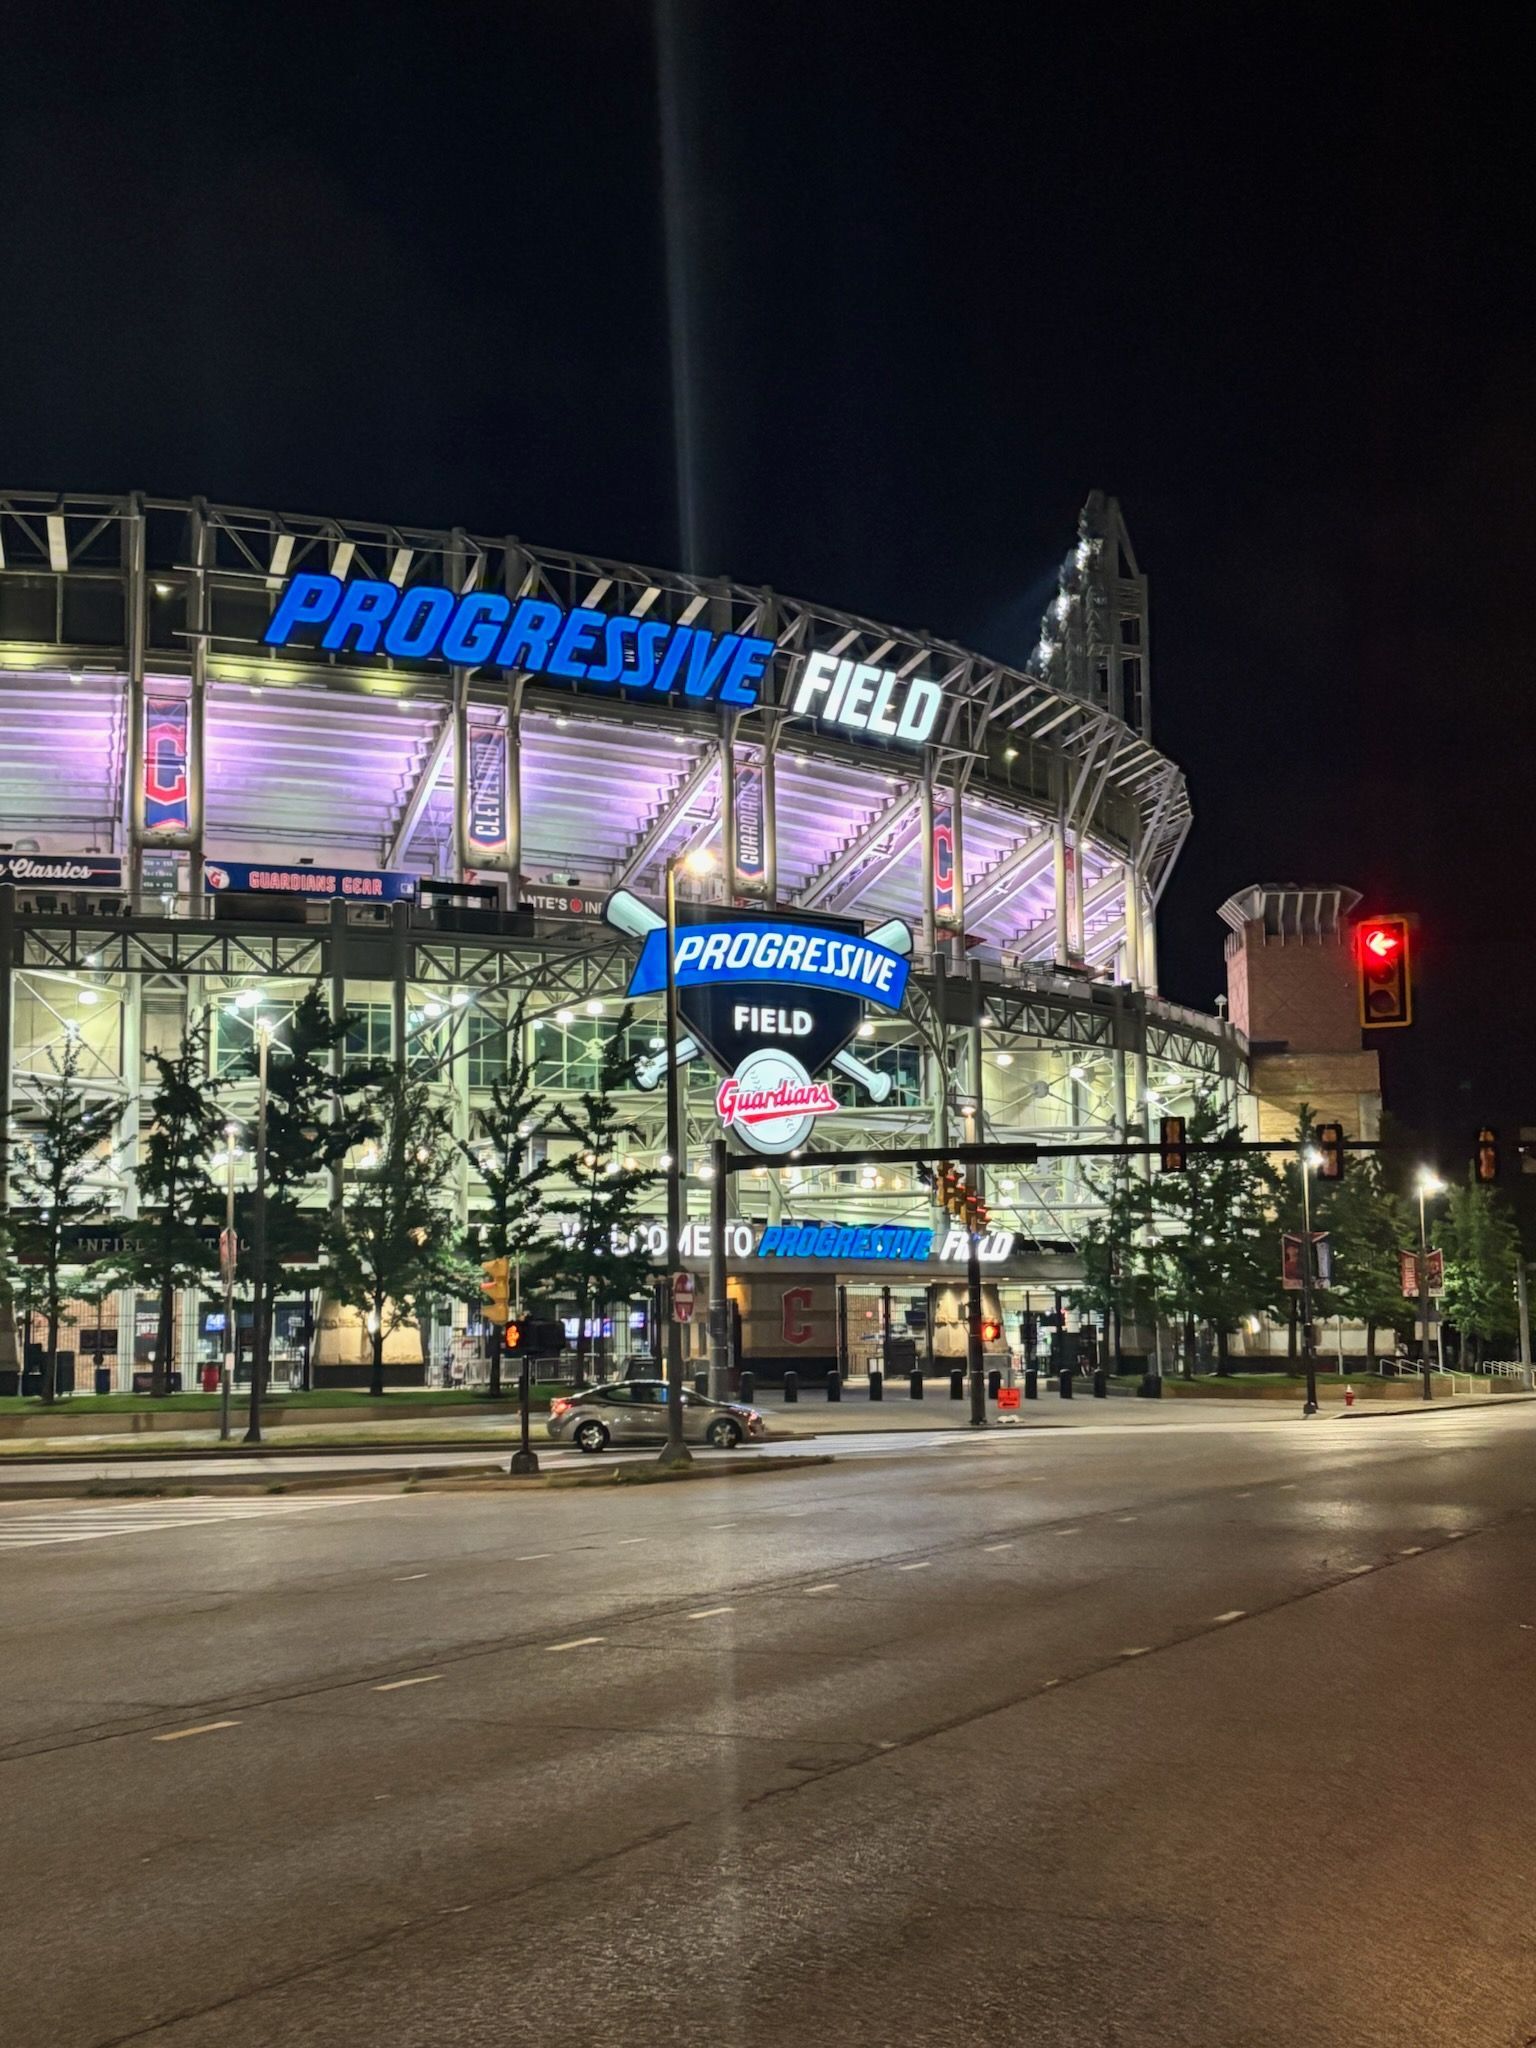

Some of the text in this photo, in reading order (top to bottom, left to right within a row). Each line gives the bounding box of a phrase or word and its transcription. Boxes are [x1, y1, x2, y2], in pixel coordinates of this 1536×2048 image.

[264, 573, 942, 742] PROGRESSIVE FIELD
[740, 781, 759, 865] GUARDIANS
[9, 858, 92, 879] Classics
[250, 871, 383, 896] GUARDIANS GEAR
[674, 932, 897, 992] PROGRESSIVE
[734, 1006, 813, 1036] FIELD
[716, 1079, 838, 1127] Guardians
[724, 1226, 753, 1258] TO
[757, 1226, 934, 1260] PROGRESSIVE
